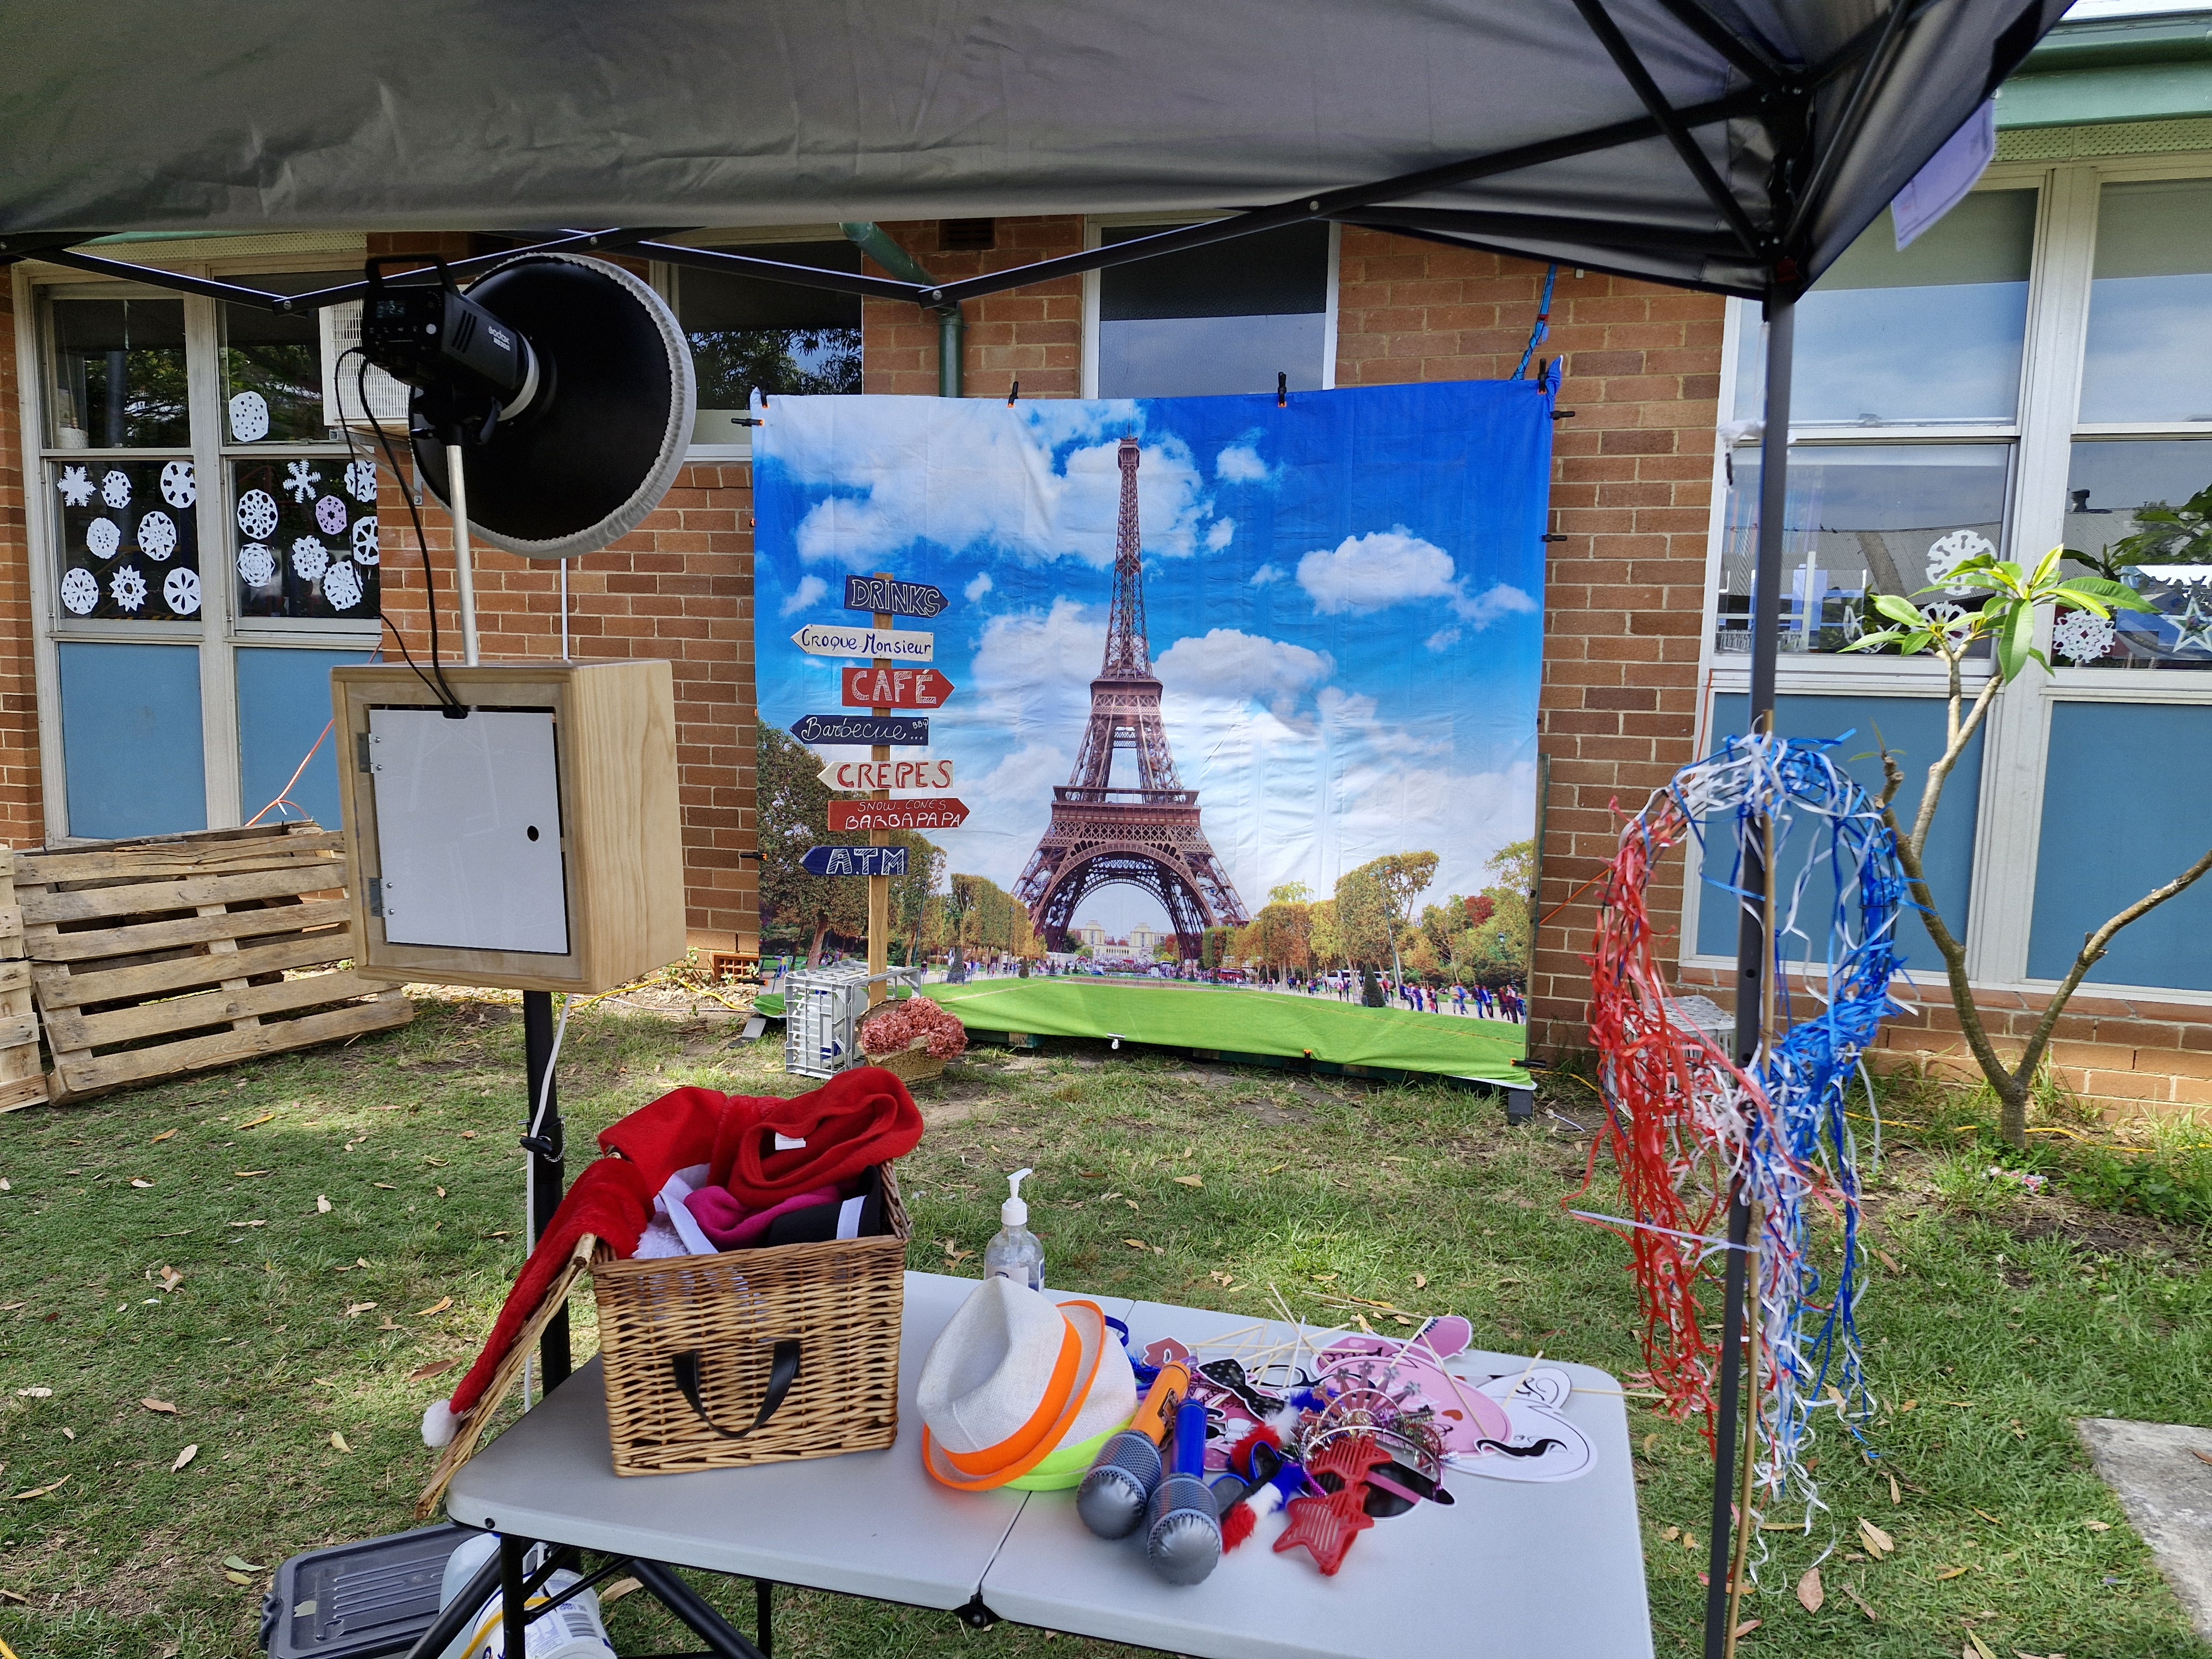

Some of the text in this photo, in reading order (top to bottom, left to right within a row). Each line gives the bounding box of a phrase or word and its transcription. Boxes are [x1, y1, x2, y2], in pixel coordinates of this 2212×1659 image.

[851, 578, 941, 618] DRINKS
[851, 669, 937, 704] CAFÉ
[912, 719, 929, 729] BBQ
[837, 760, 952, 789] CREPES
[845, 812, 961, 830] BARBAPAPA
